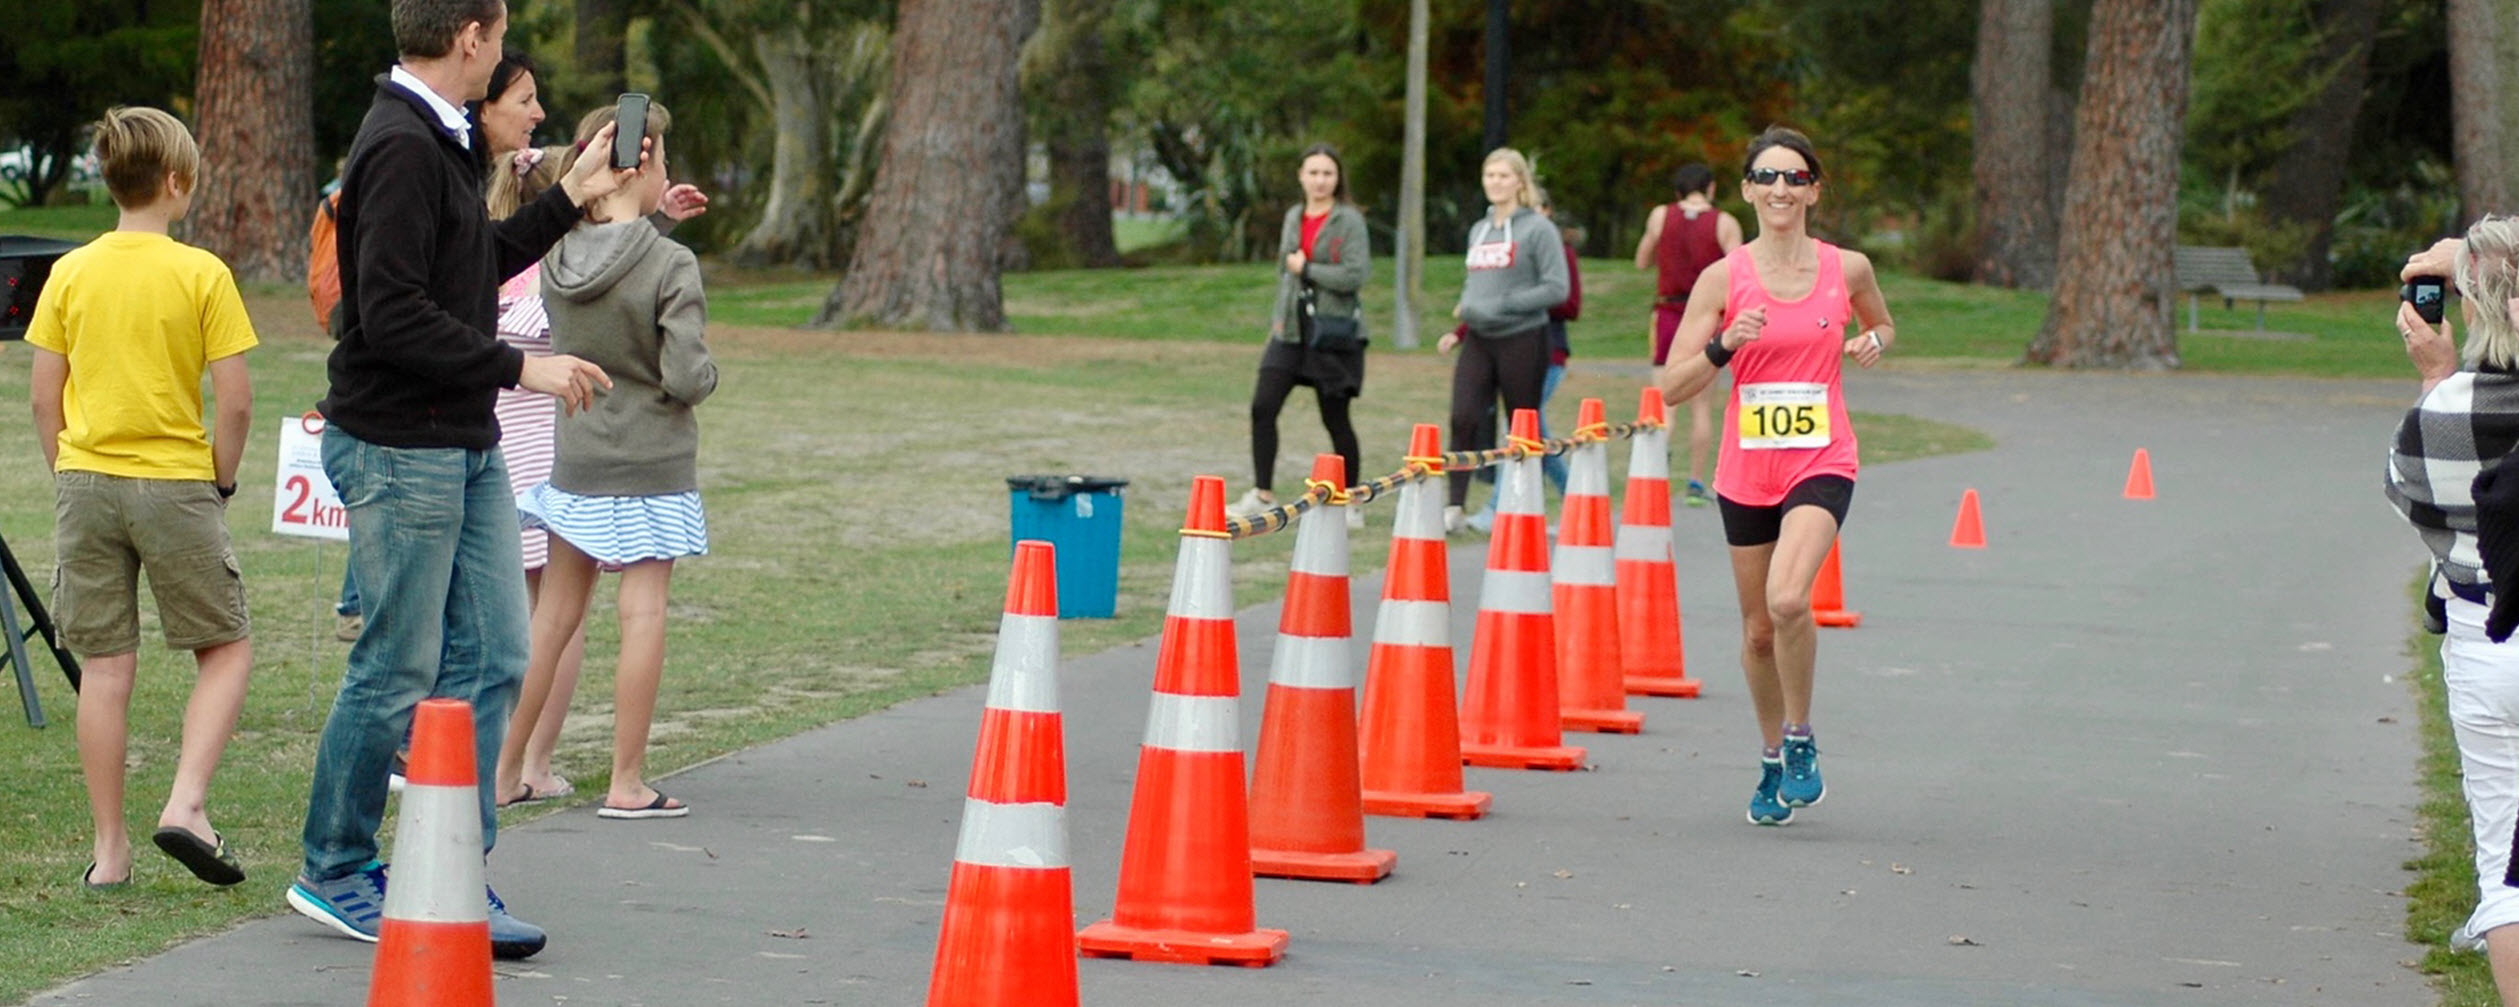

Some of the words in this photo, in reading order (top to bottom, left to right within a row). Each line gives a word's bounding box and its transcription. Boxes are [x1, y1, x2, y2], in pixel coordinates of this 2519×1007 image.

[1752, 405, 1815, 436] 105
[282, 474, 310, 524] 2
[312, 497, 349, 528] km
